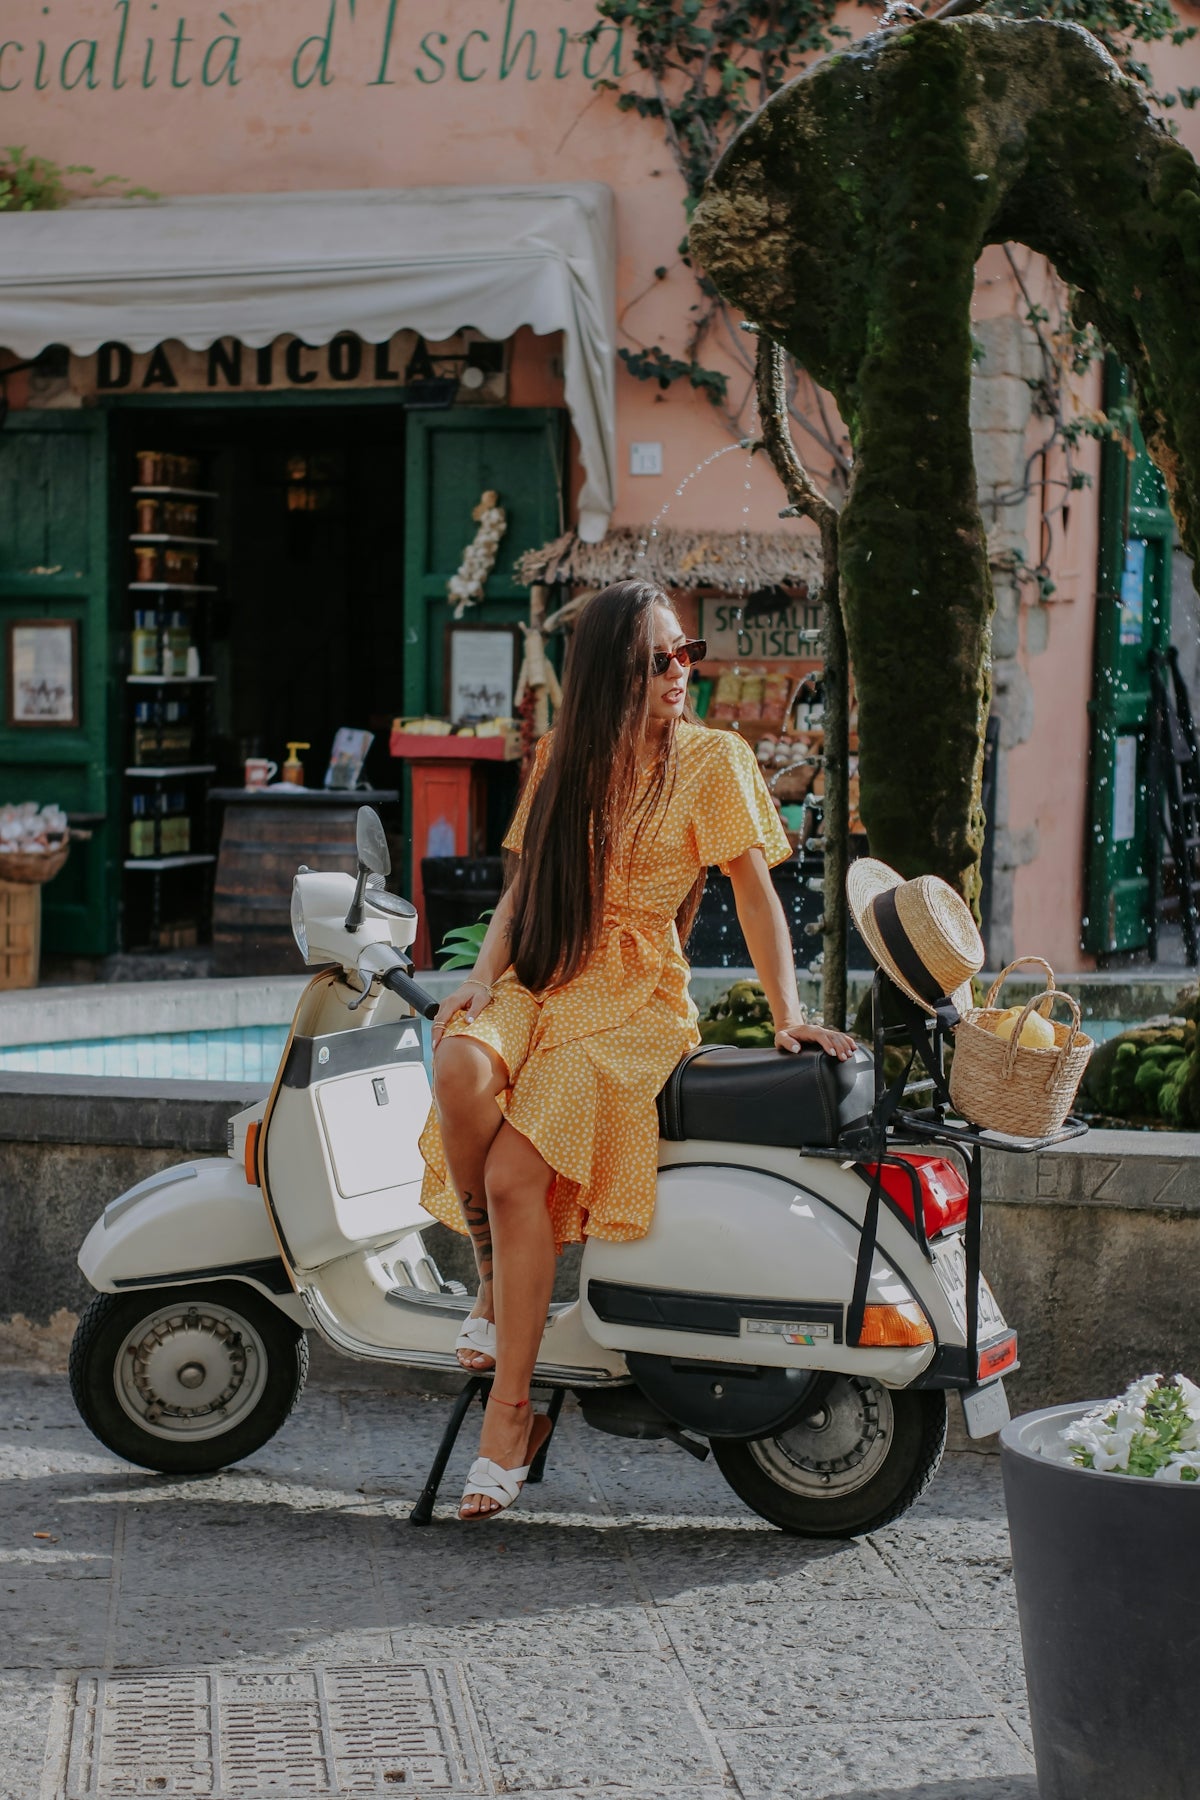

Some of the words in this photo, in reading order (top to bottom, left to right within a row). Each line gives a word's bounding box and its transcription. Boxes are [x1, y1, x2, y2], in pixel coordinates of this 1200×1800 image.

[0, 0, 243, 92] cialità
[291, 0, 627, 89] d'Ischia
[99, 341, 178, 388] DA
[208, 331, 437, 387] NICOLA
[715, 605, 823, 632] SPECIALIT
[738, 631, 824, 657] D'ISCHI
[781, 1323, 808, 1336] 125
